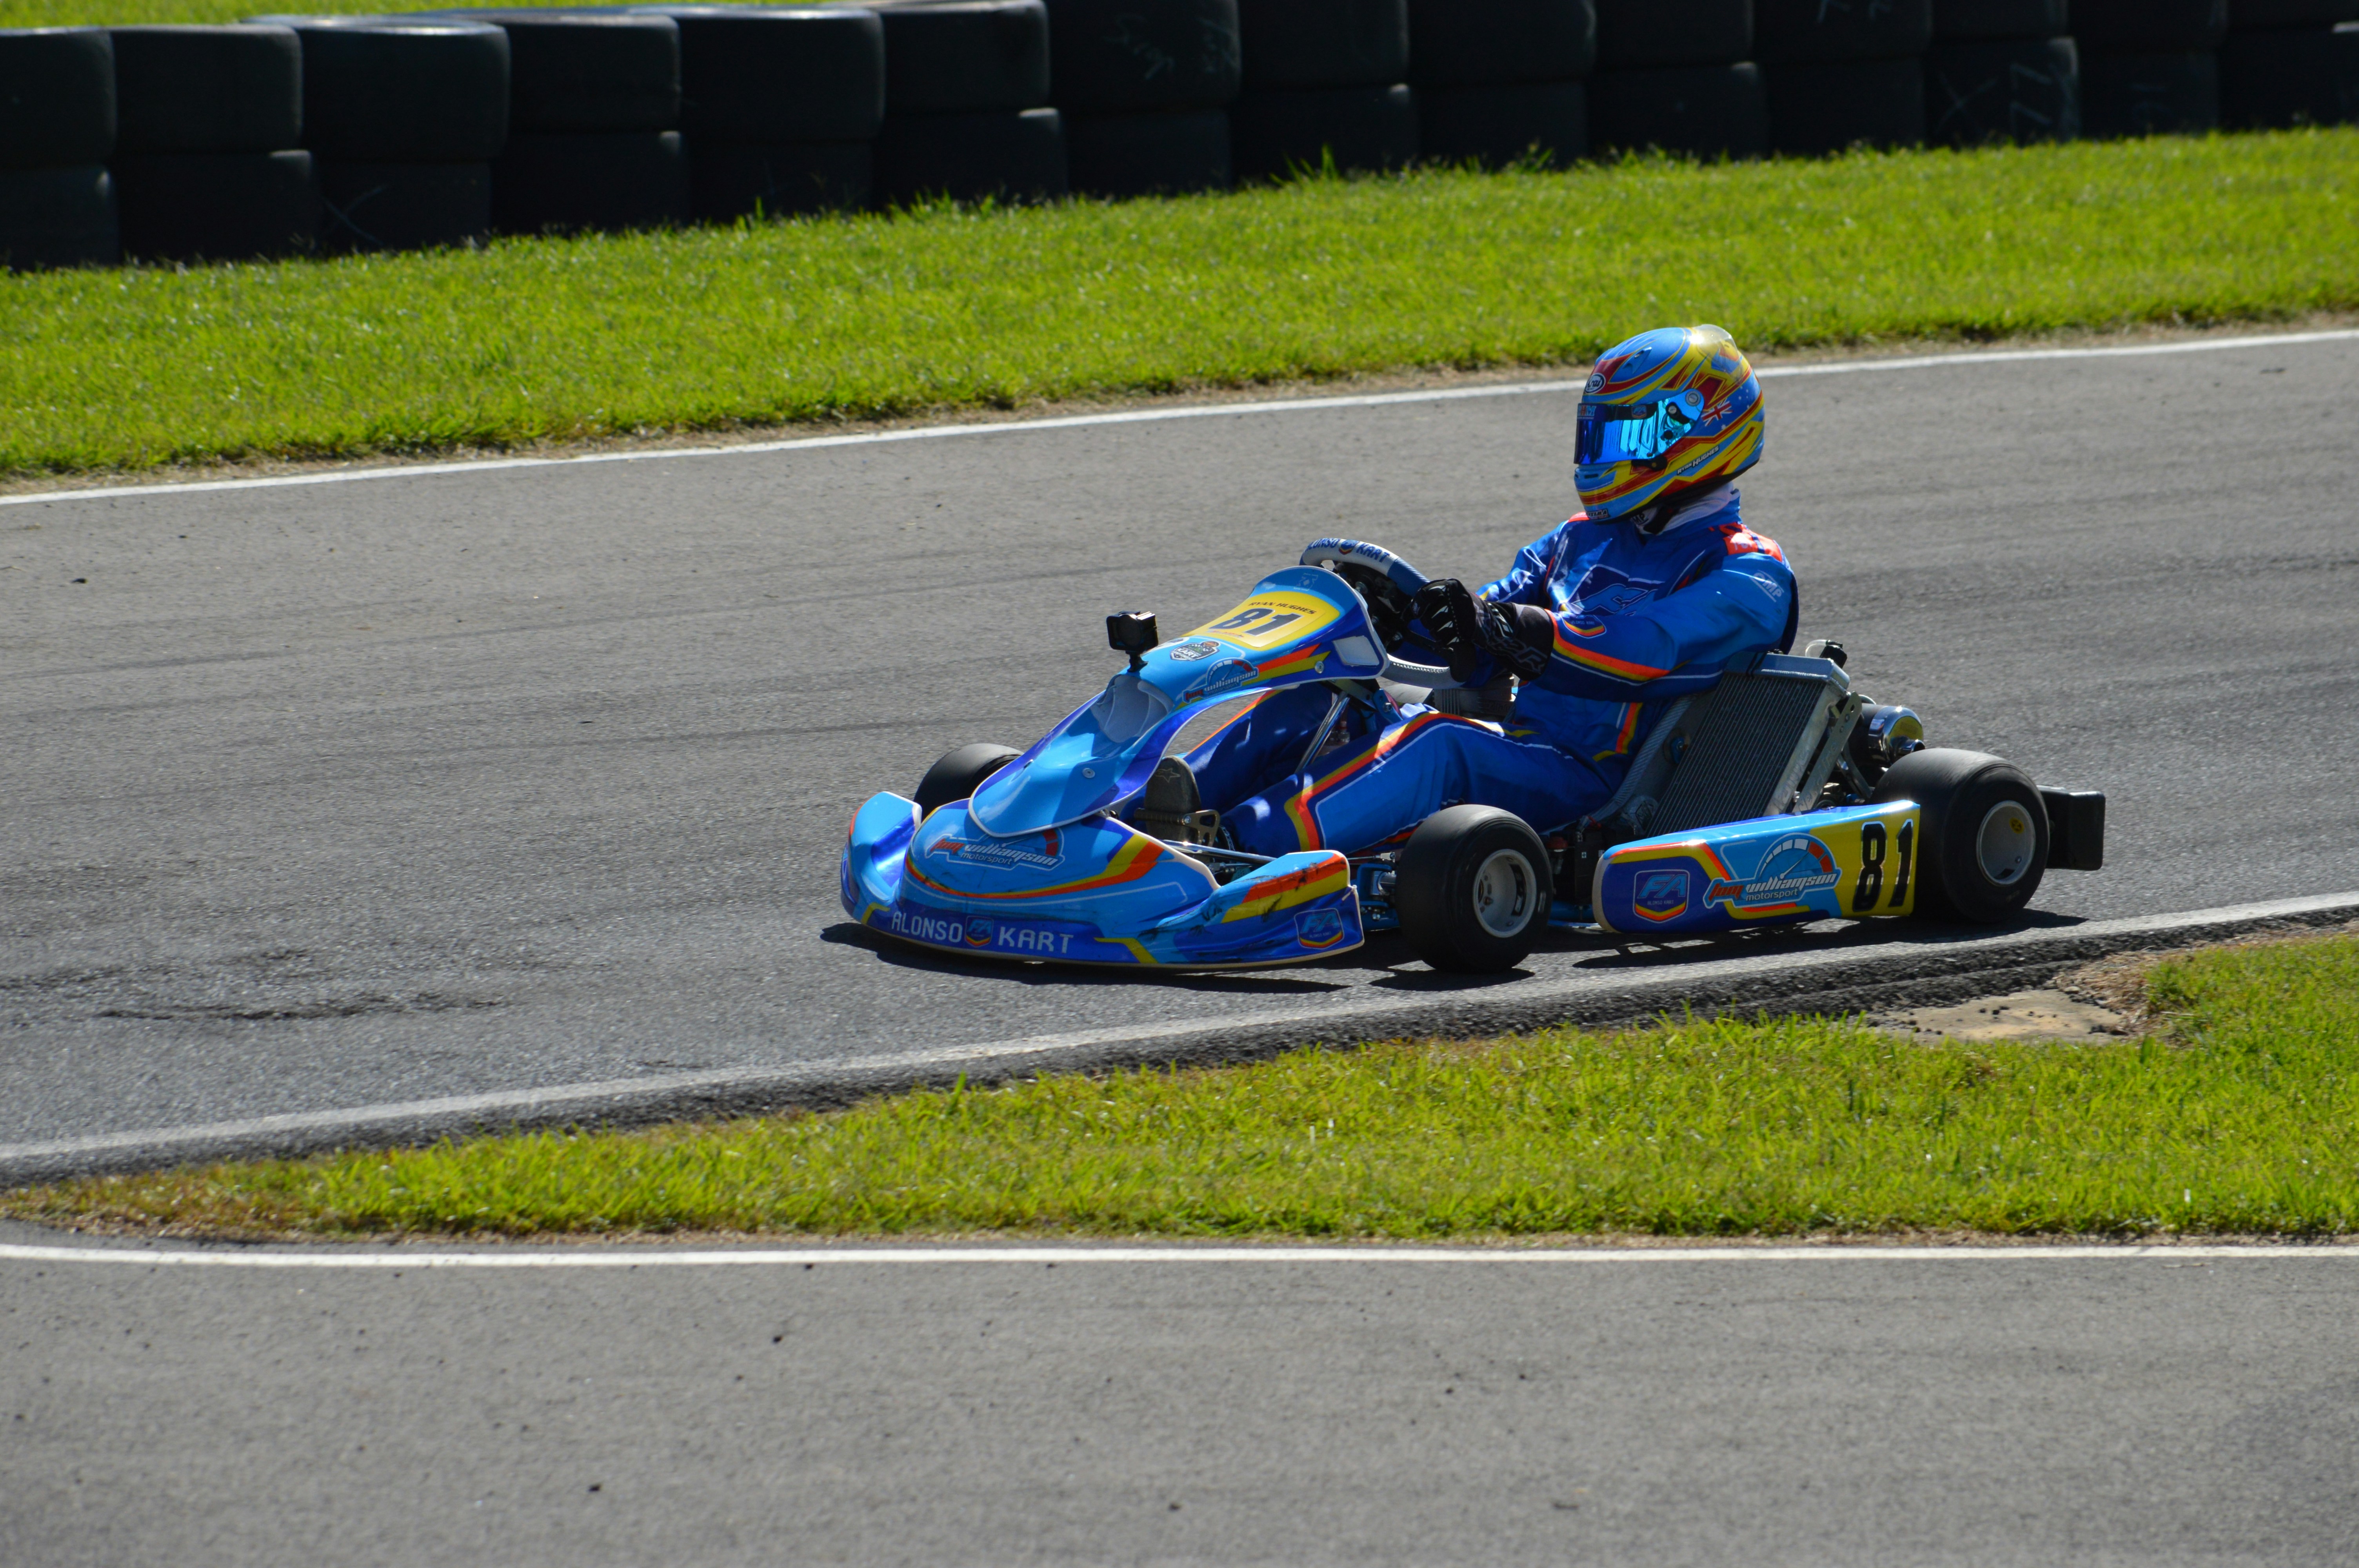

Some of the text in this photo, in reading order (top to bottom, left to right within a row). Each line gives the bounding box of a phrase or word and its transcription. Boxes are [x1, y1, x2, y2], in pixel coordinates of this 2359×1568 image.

[1677, 445, 1719, 474] RYAN HUGHES
[1356, 543, 1390, 563] KART
[1753, 572, 1783, 597] OMP
[1276, 603, 1317, 615] HUGHES
[1208, 608, 1304, 637] 81
[1177, 648, 1199, 658] KART
[961, 852, 1013, 865] motorsport
[964, 843, 1059, 866] williamson
[1852, 818, 1914, 912] 81
[1637, 874, 1687, 898] FA
[1745, 873, 1837, 893] williamson
[1746, 888, 1798, 901] motorsport
[891, 911, 963, 943] ALONSO
[998, 926, 1074, 954] KART
[1300, 911, 1340, 933] FA
